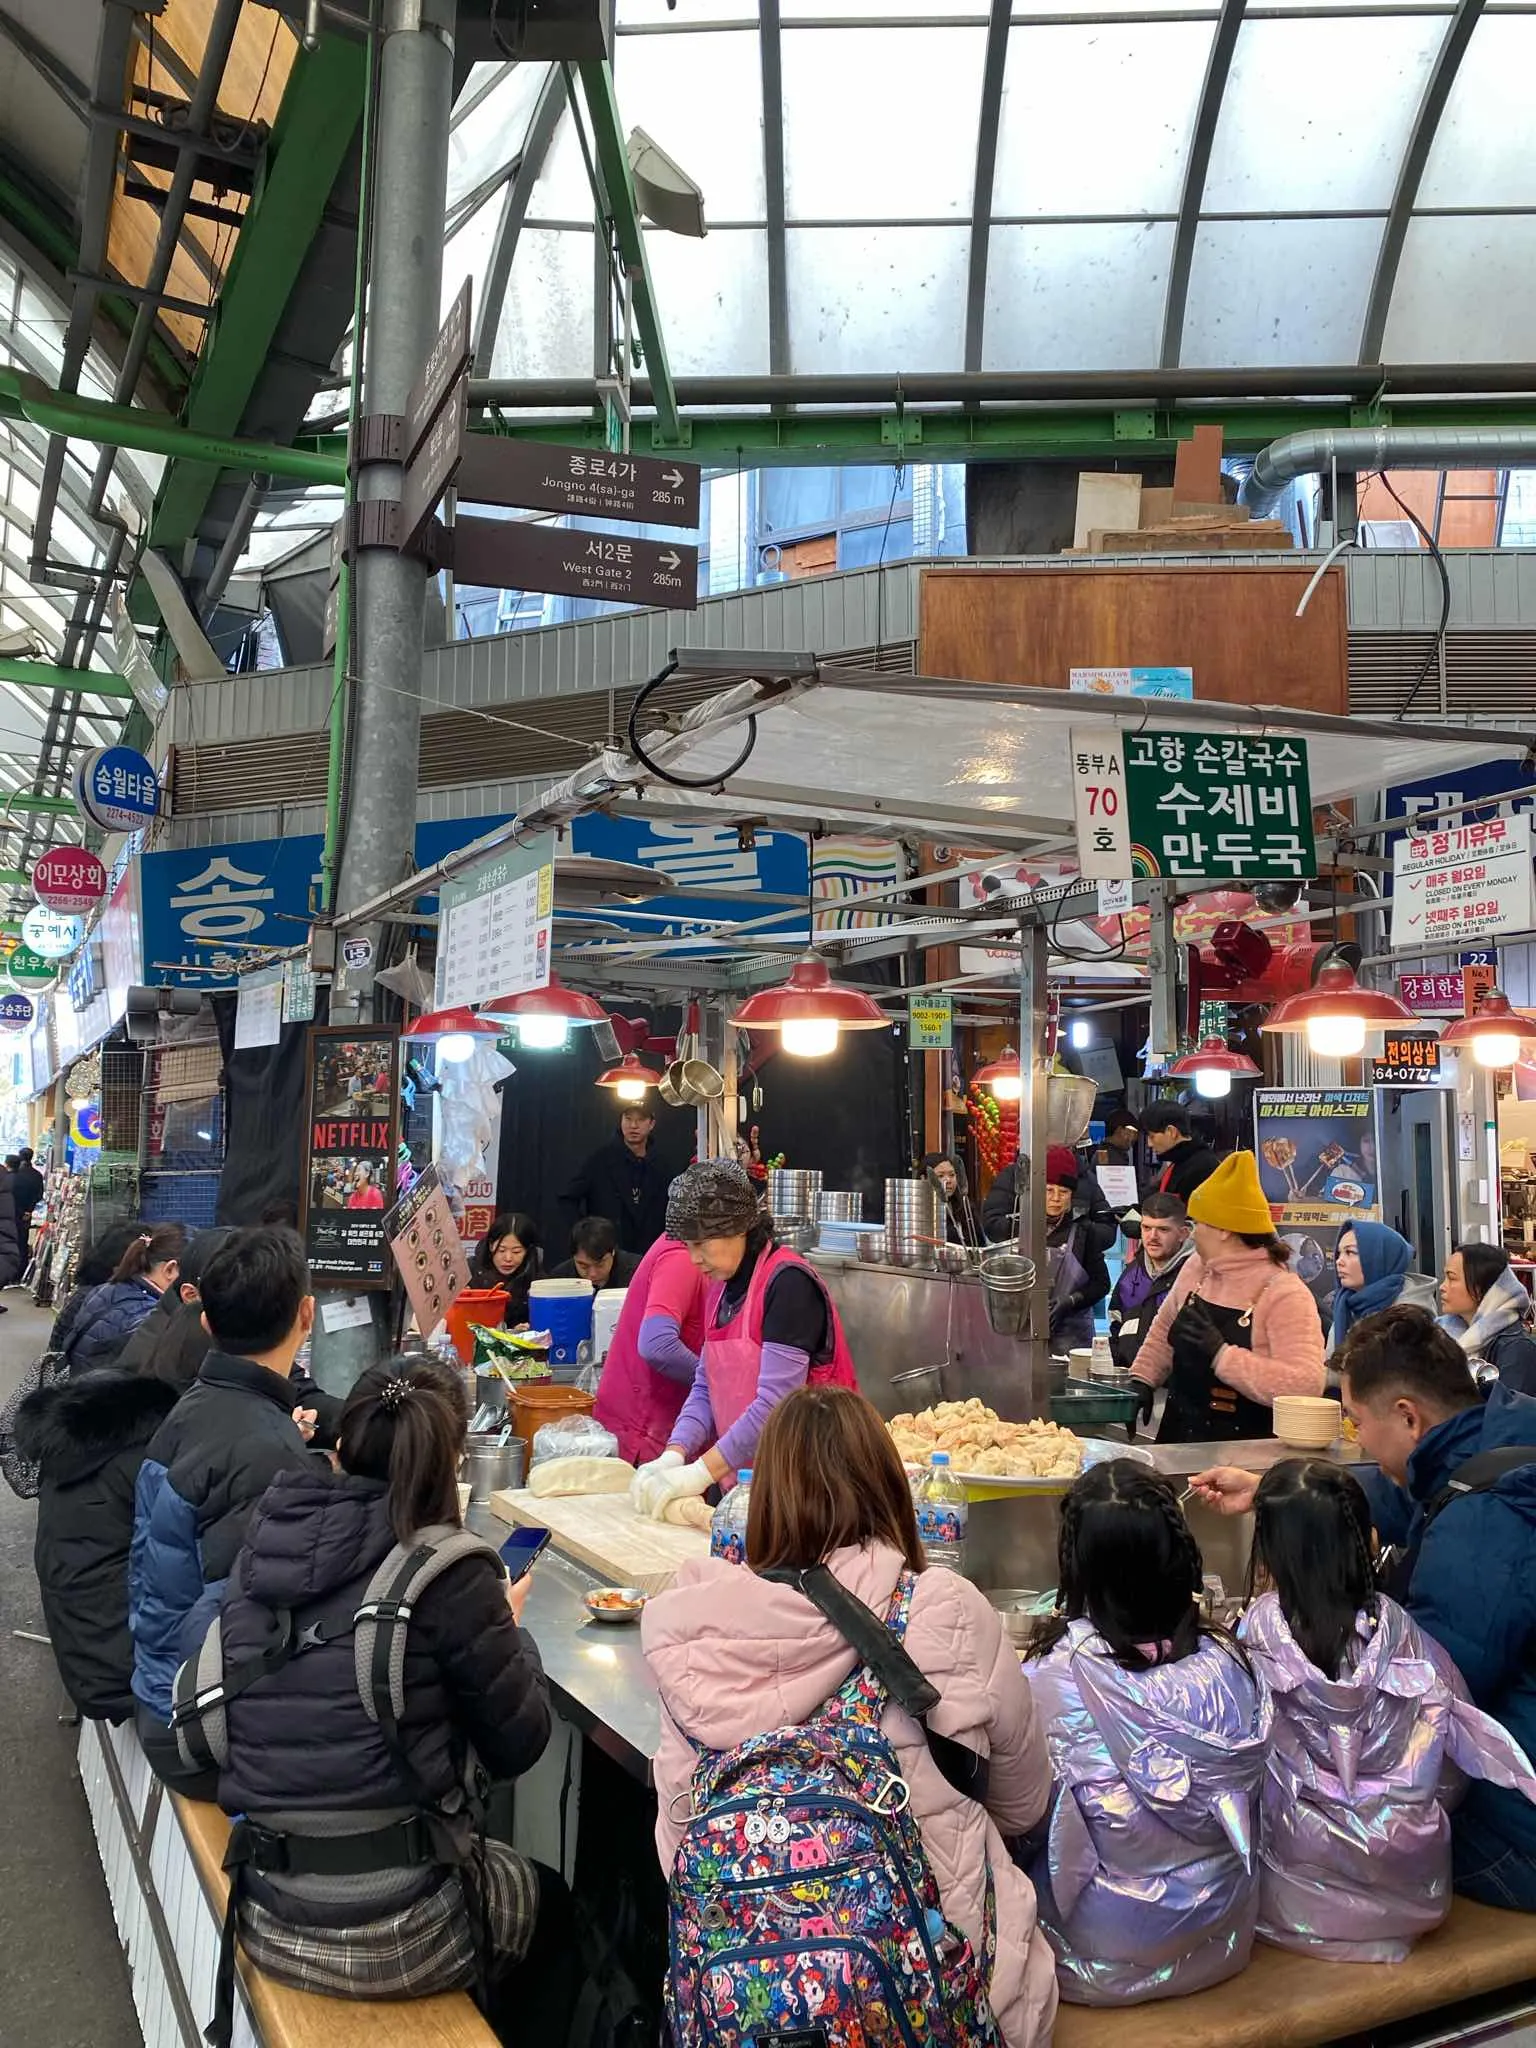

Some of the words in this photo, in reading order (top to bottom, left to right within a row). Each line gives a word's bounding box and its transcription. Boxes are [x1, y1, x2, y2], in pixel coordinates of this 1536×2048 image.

[569, 455, 637, 482] 종로4가
[542, 476, 586, 491] Jongno
[589, 482, 635, 499] 4(sa)-ga
[652, 490, 671, 504] 285
[674, 495, 685, 505] m
[585, 540, 633, 564] 서2문
[562, 561, 592, 574] West
[595, 565, 622, 578] Gate
[625, 569, 632, 580] 2
[1129, 737, 1185, 773] 고향
[1193, 738, 1302, 779] 손칼국수
[95, 764, 156, 806] 송월타올
[1085, 786, 1118, 816] 70
[1156, 782, 1300, 827] 수제비
[1093, 827, 1117, 852] 호
[1162, 832, 1307, 876] 만두국
[1402, 859, 1434, 872] REGULAR
[1435, 853, 1465, 867] HOLIDAY
[37, 862, 102, 891] 이모상회
[1425, 888, 1451, 898] CLOSED
[1463, 882, 1485, 891] EVERY
[1486, 875, 1518, 887] MONDAY
[1426, 872, 1448, 888] 매주
[1451, 865, 1486, 884] 월요일
[1463, 900, 1498, 919] 일요일
[1424, 924, 1451, 934] CLOSED
[1451, 922, 1461, 930] ON
[1477, 914, 1507, 926] SUNDAY
[1469, 953, 1487, 965] 22
[1309, 1104, 1370, 1117] 아이스크림
[313, 1122, 389, 1150] NETFLIX
